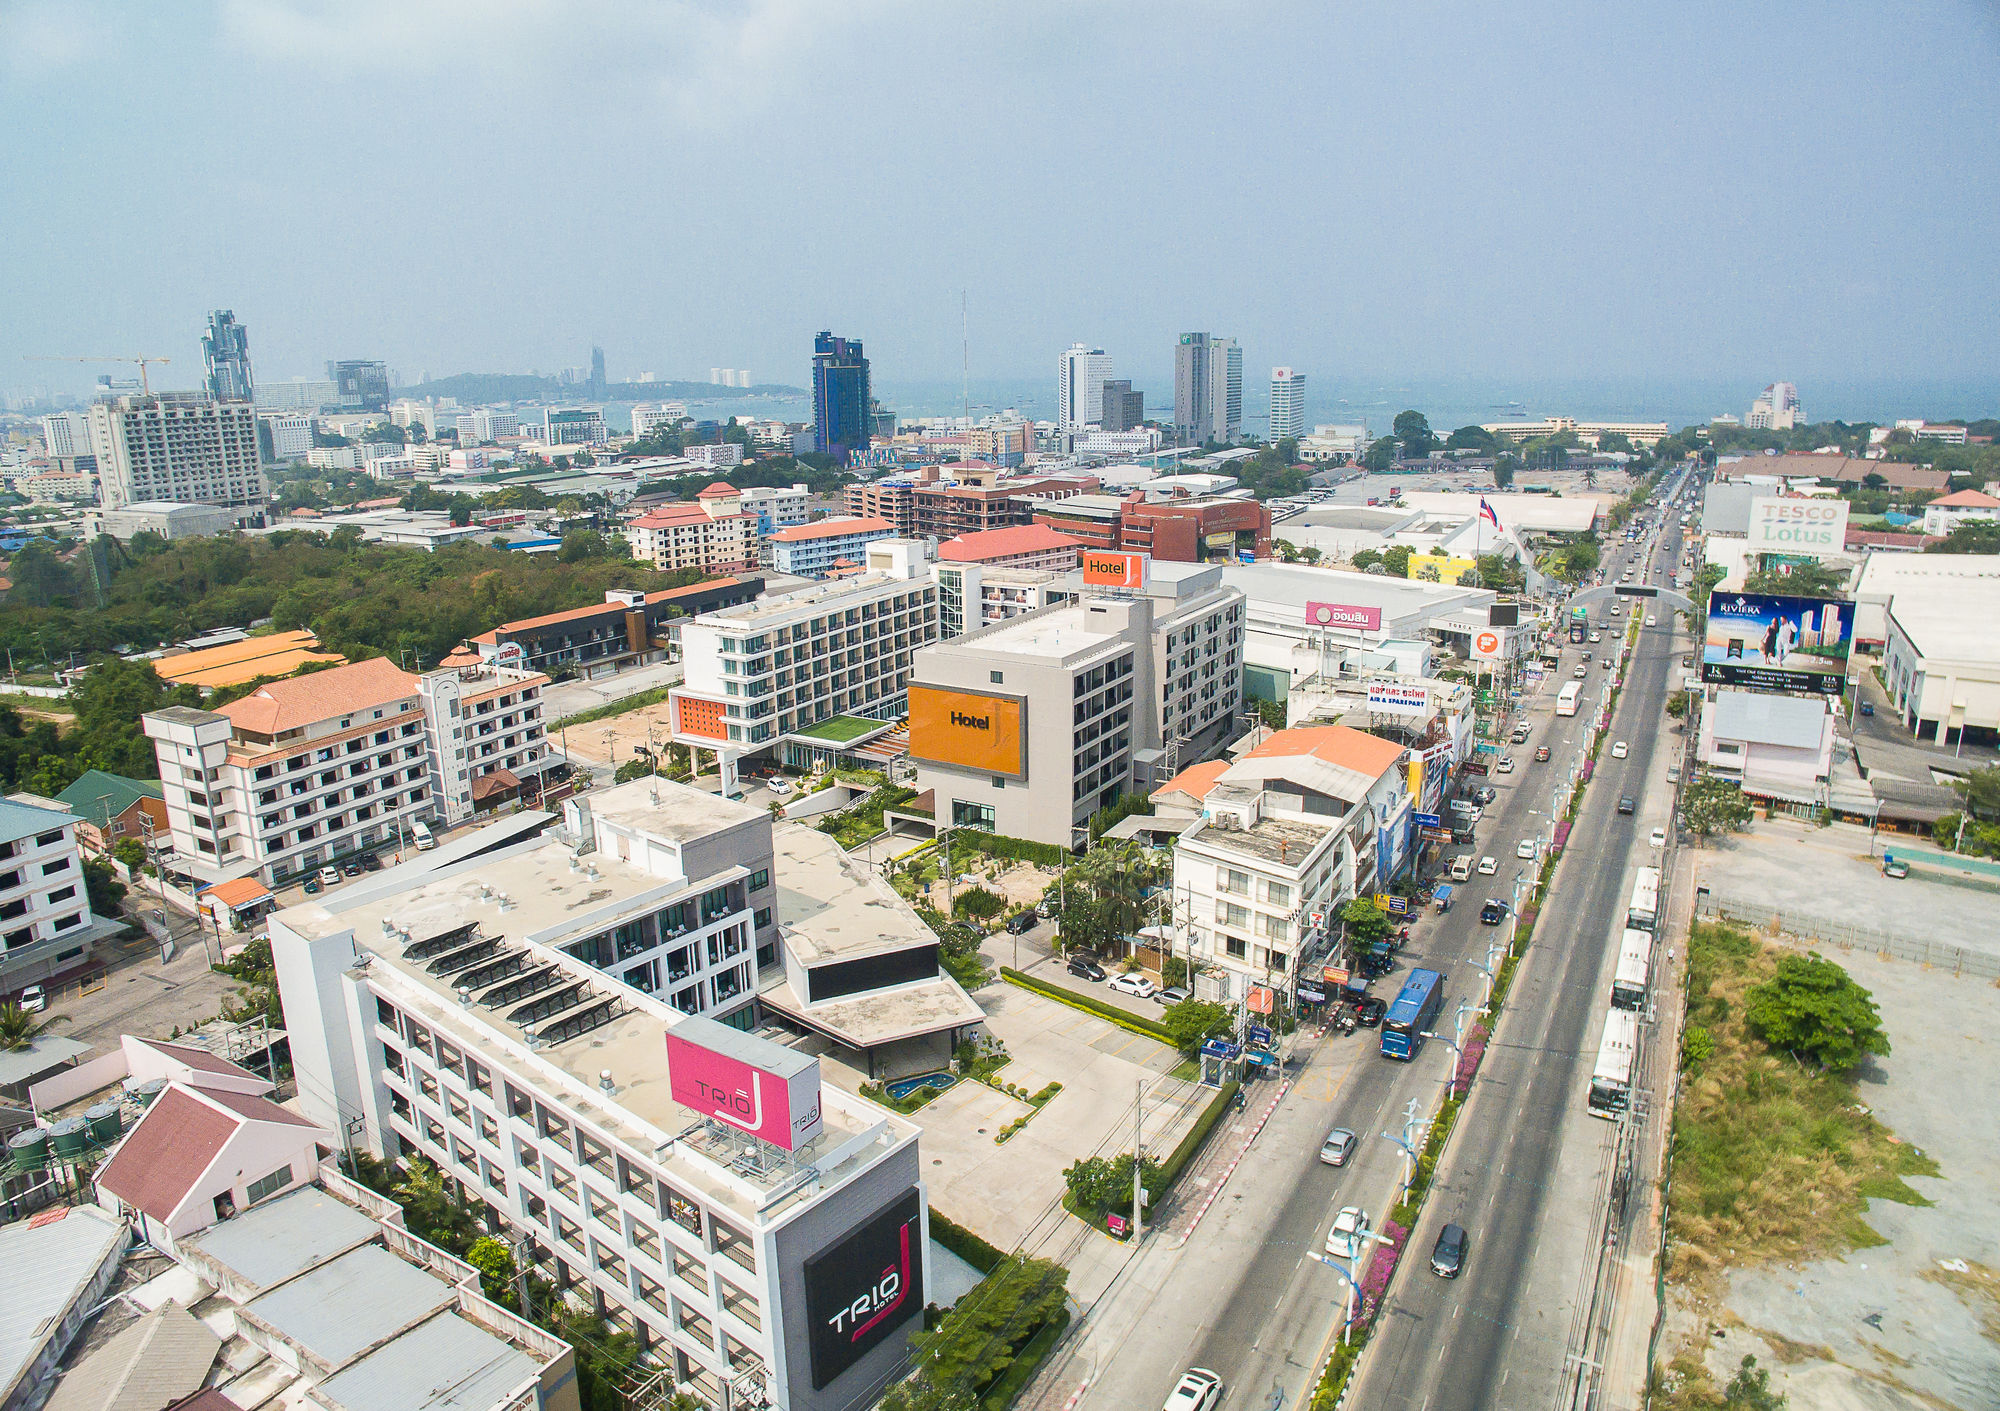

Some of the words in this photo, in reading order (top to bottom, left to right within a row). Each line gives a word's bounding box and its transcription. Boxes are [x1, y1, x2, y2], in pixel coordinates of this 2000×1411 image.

[1762, 505, 1837, 520] TESCO
[1764, 525, 1832, 544] Lotus
[1090, 560, 1124, 574] Hotel
[1720, 603, 1761, 614] RIVIERA
[1333, 611, 1368, 623] ออมสิน
[950, 710, 990, 730] Hotel
[874, 1291, 899, 1312] HOTEL
